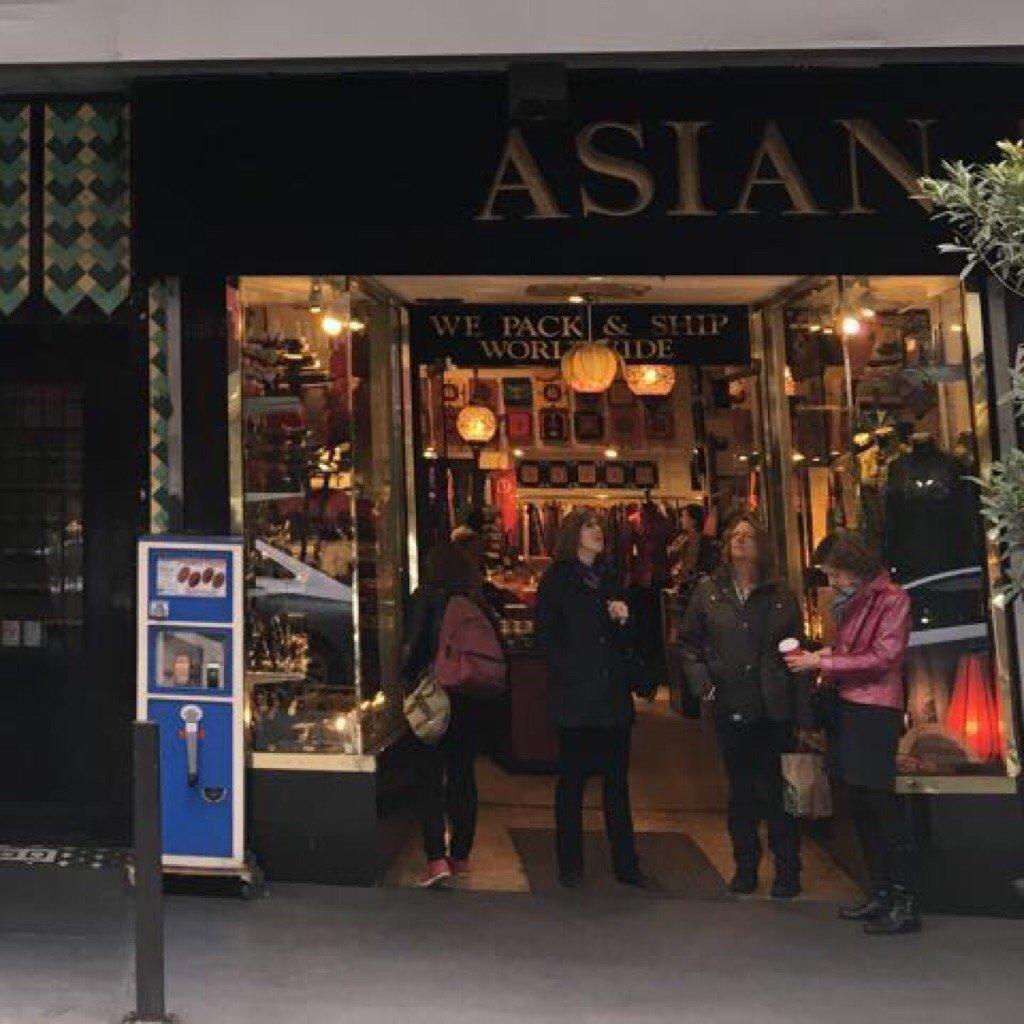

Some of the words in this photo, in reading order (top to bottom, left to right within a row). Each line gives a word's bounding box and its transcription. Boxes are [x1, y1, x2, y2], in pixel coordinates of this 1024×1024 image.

[475, 118, 939, 221] ASIAN
[430, 315, 479, 337] WE
[501, 314, 582, 338] PACK
[602, 315, 630, 337] &
[651, 313, 729, 337] SHIP
[479, 338, 675, 360] WORLIDE
